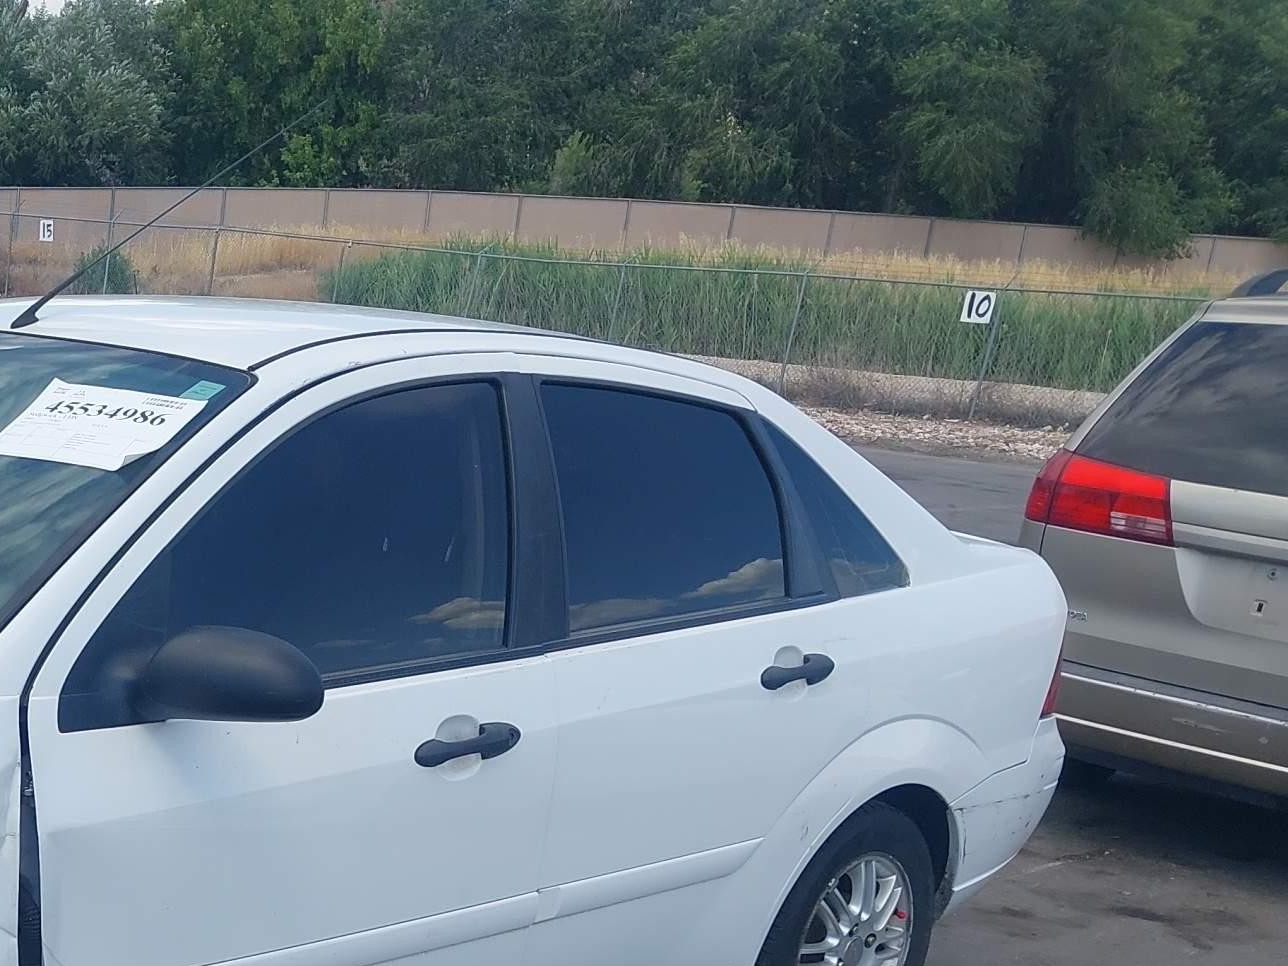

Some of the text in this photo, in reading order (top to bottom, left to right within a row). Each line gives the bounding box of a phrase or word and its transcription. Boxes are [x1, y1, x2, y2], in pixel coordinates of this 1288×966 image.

[42, 221, 52, 239] 15
[967, 292, 992, 319] 10
[44, 400, 169, 426] 45534986
